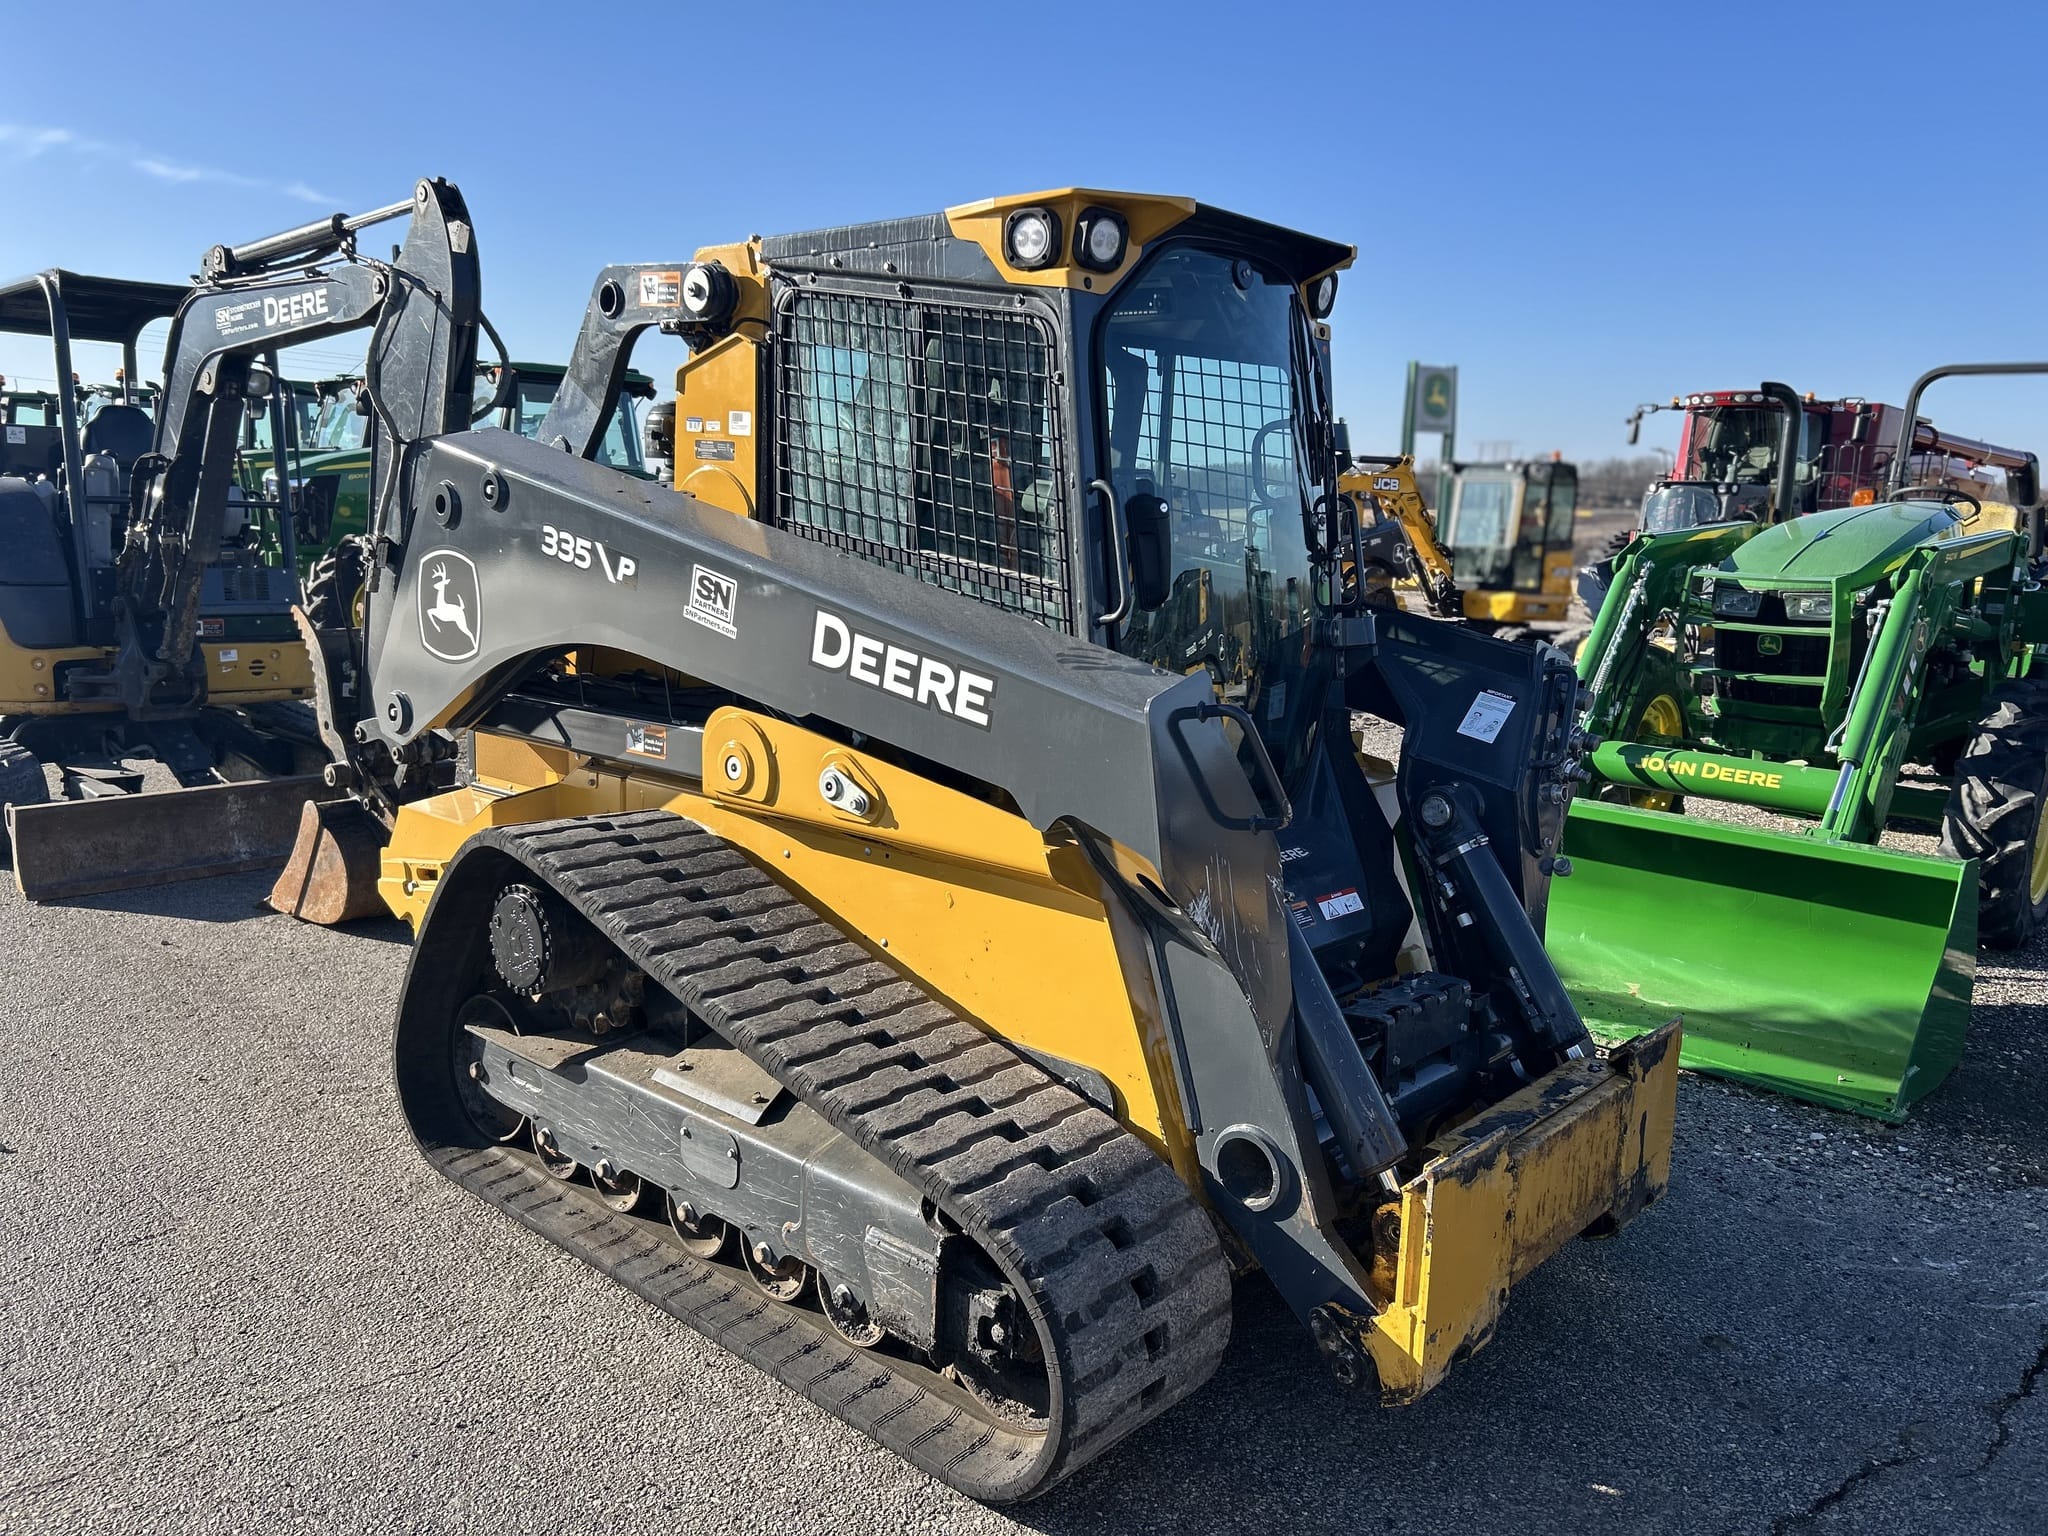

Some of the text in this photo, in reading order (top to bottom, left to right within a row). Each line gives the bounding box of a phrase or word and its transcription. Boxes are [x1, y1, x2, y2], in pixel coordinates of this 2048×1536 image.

[216, 307, 231, 323] SN
[263, 287, 329, 327] DEERE
[1373, 478, 1400, 491] JCB
[696, 574, 732, 611] SN
[684, 608, 736, 637] SNPartners.com
[694, 598, 729, 619] PARTNERS
[811, 609, 994, 727] DEERE
[1635, 754, 1783, 789] JOHN DEERE
[1280, 847, 1310, 863] ERE
